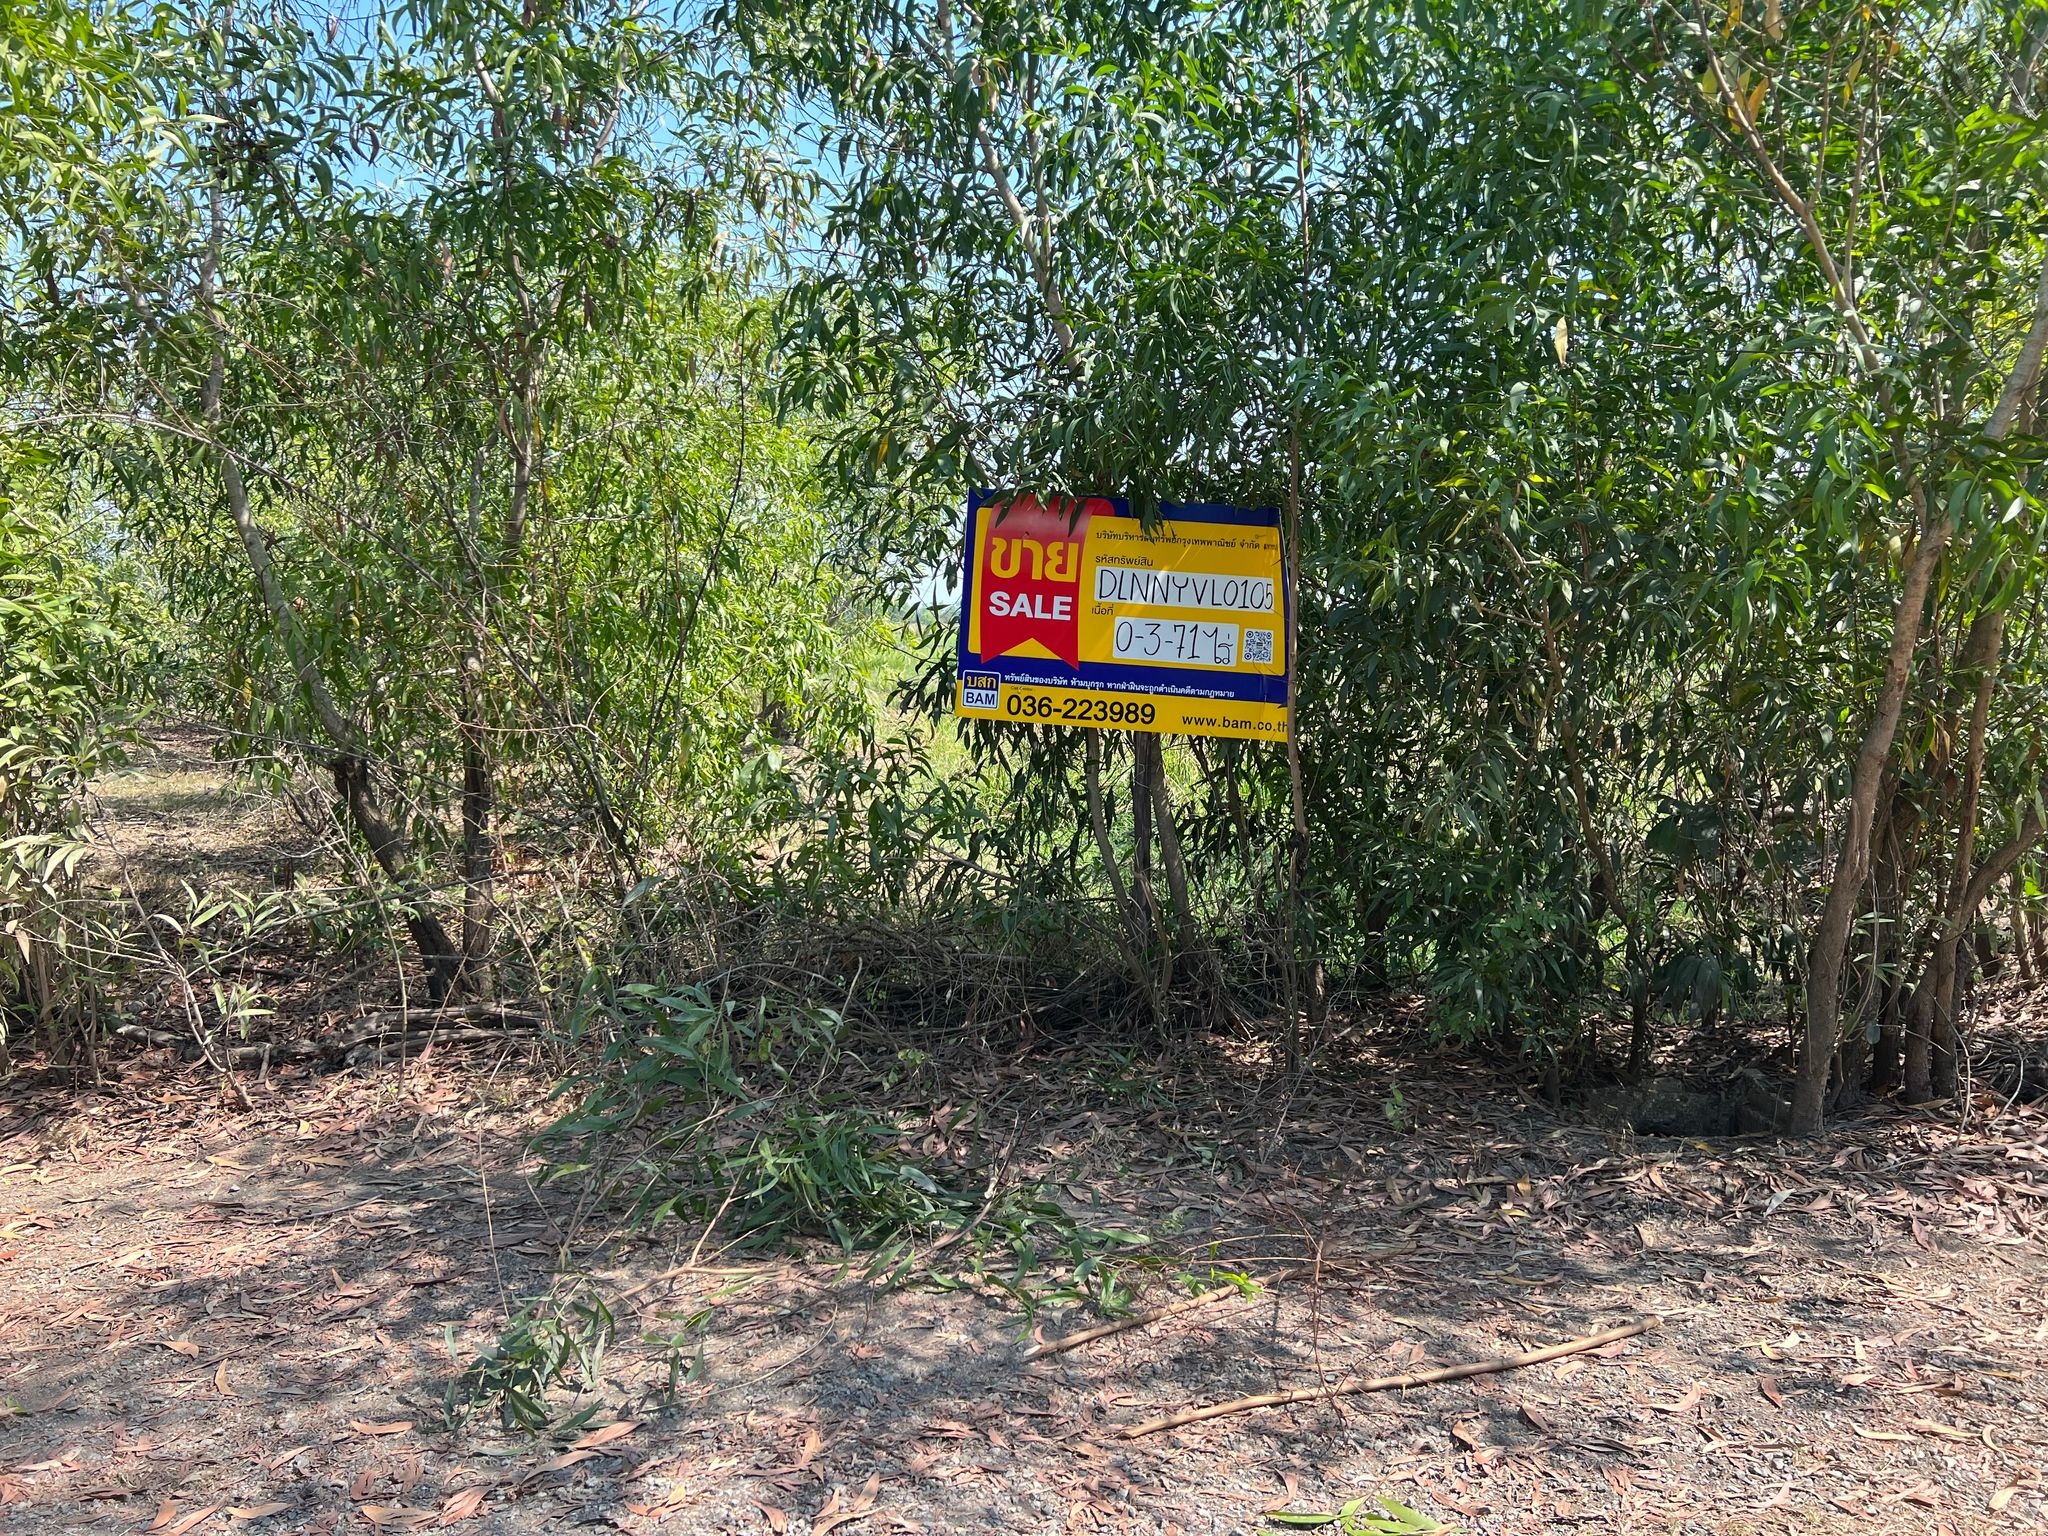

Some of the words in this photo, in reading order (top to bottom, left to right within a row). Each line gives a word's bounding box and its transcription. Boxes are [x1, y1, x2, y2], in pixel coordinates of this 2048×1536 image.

[1239, 539, 1261, 550] จำกัด
[990, 537, 1079, 583] ขาย
[1095, 554, 1154, 567] รหัสทรัพย์สิน
[1099, 569, 1274, 610] DLNNYVL0105
[988, 590, 1073, 621] SALE
[1091, 602, 1114, 616] เนื้อที่
[967, 675, 997, 689] บสก
[1004, 672, 1068, 686] ทรัพย์สินของบริษัท
[1070, 677, 1105, 691] ห้ามบุกรุก
[965, 691, 995, 706] BAM
[1006, 694, 1156, 726] 036-223989
[1182, 715, 1288, 733] www.bam.co.th
